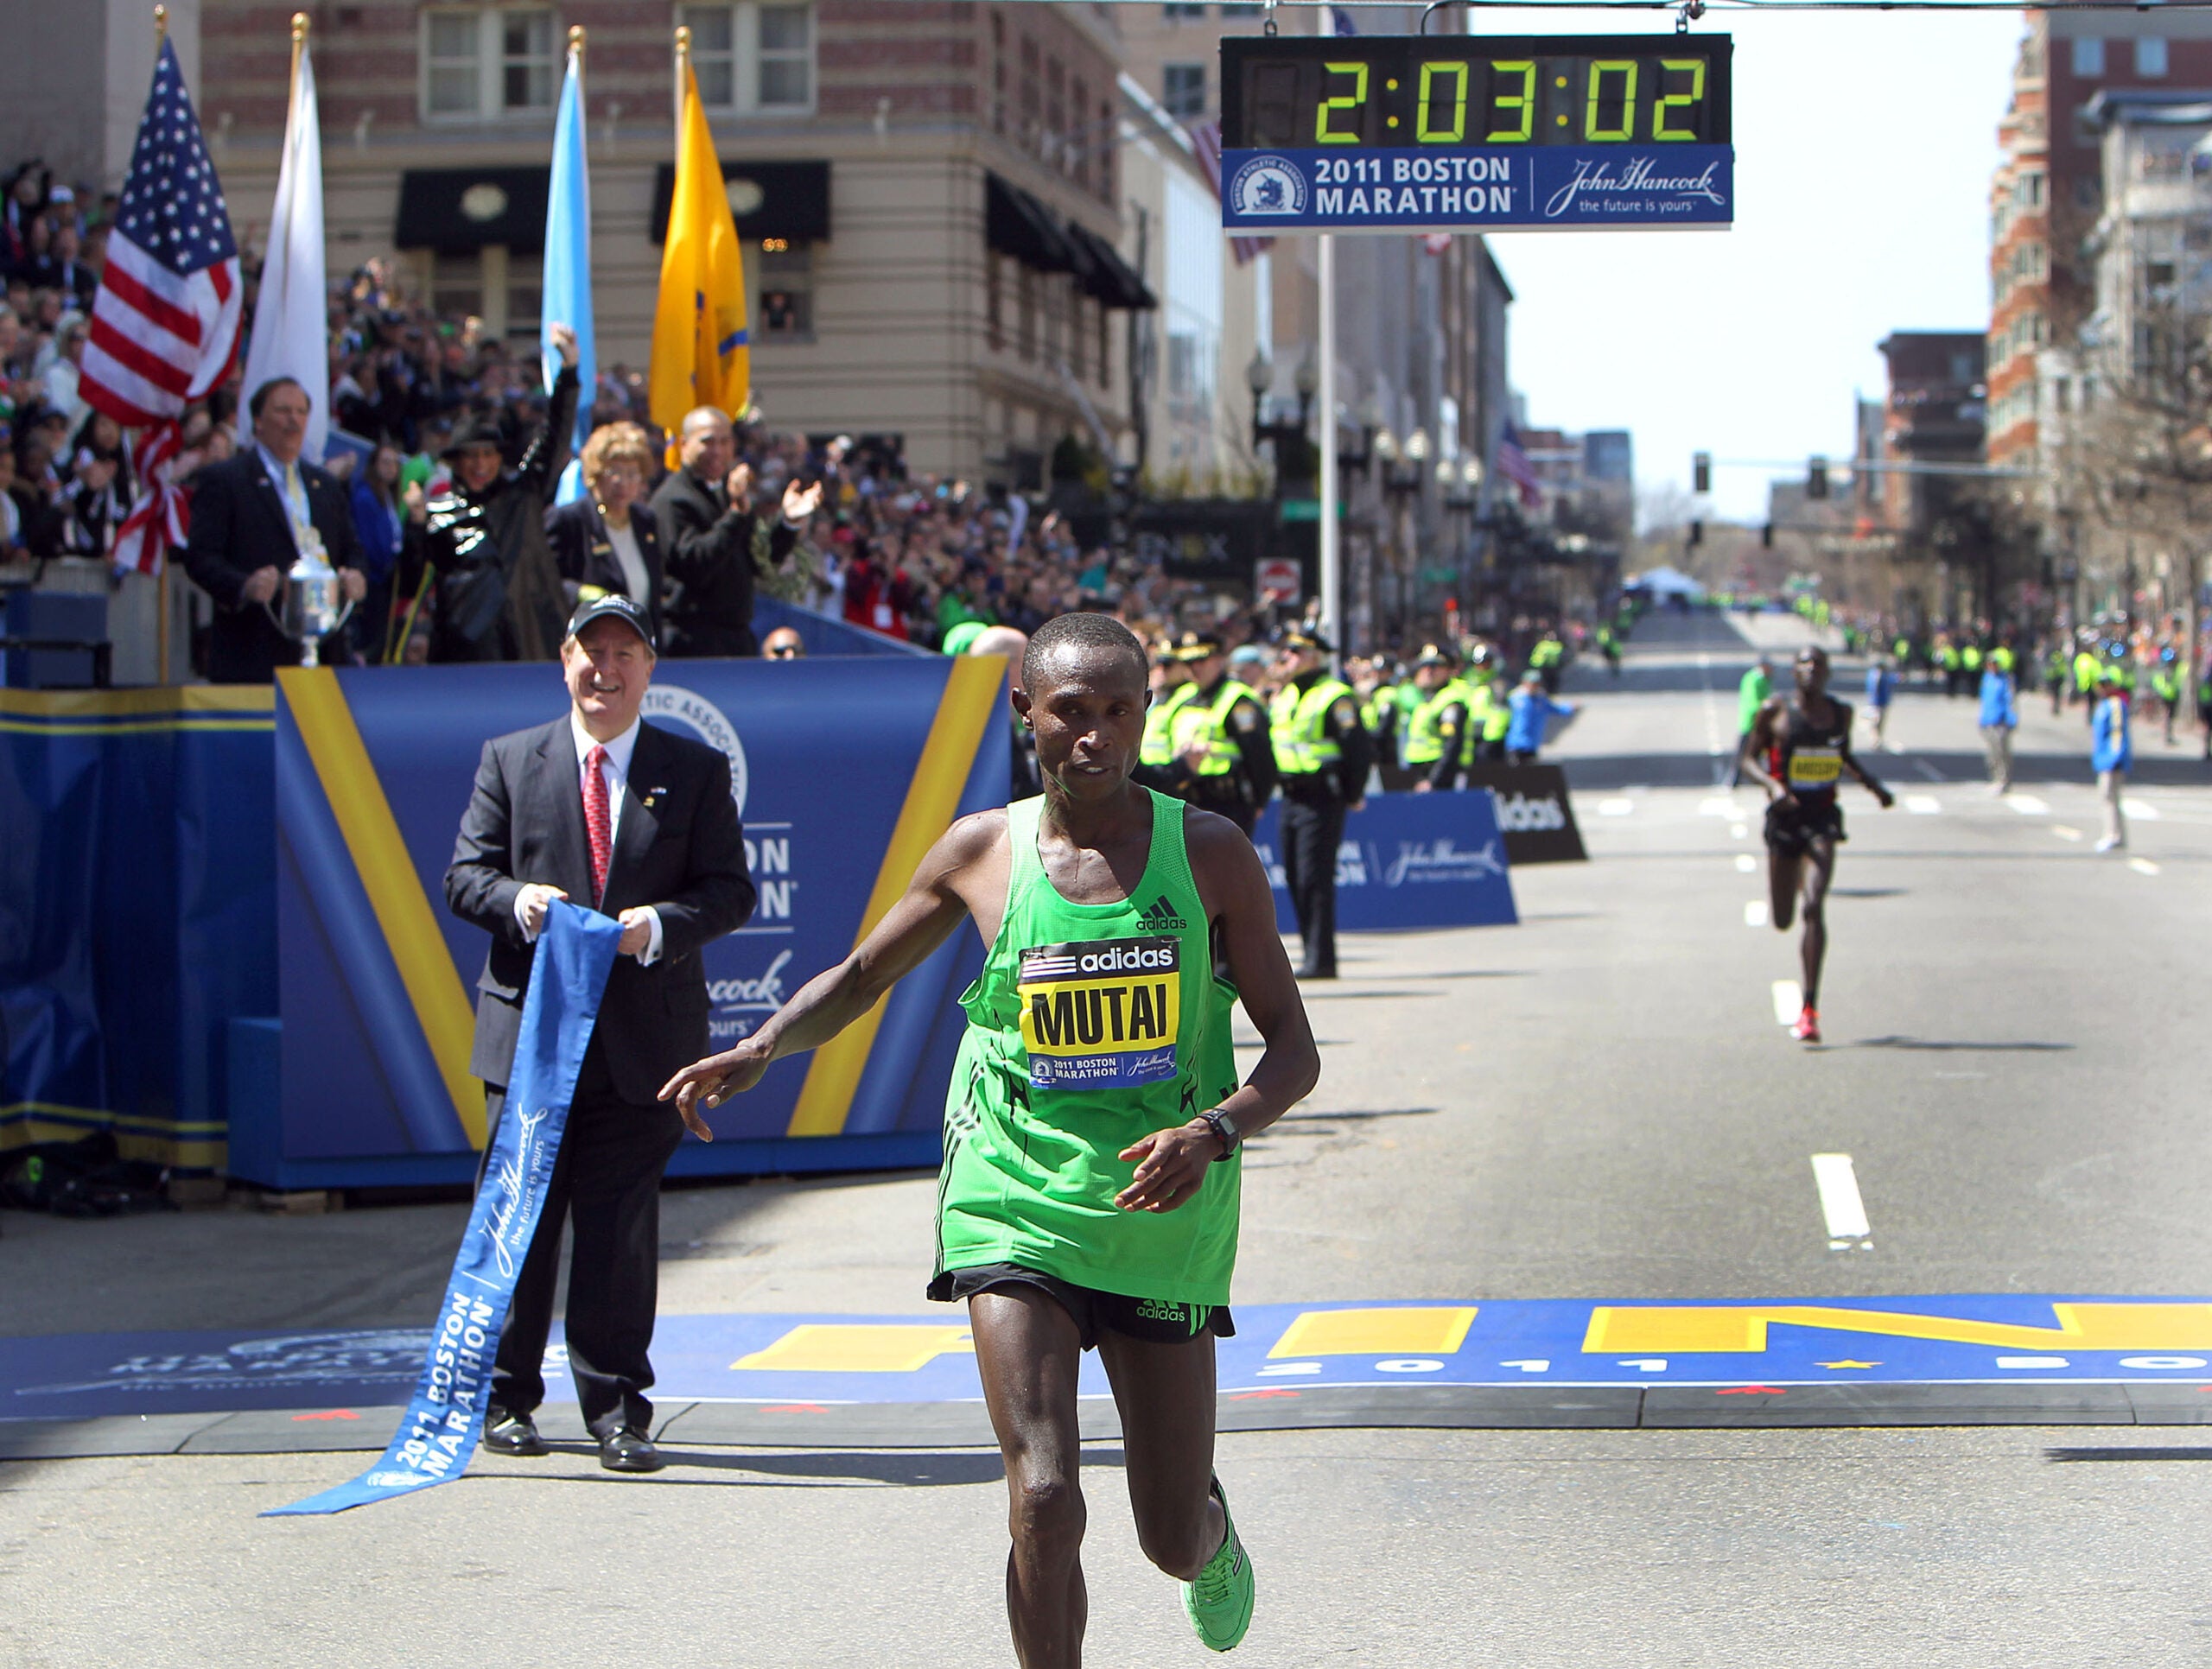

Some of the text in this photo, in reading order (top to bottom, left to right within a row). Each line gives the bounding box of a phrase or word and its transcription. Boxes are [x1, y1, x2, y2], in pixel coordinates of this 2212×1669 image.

[1315, 60, 1706, 143] 2:03:02
[1315, 157, 1510, 183] 2011 BOSTON
[1545, 156, 1726, 217] John Hancock
[1316, 187, 1511, 214] MARATHON
[1580, 199, 1693, 214] the future is yours
[1136, 917, 1187, 931] adidas
[1080, 946, 1173, 973] adidas
[1031, 983, 1166, 1047] MUTAI
[1053, 1057, 1116, 1069] 2011 BOSTON
[1054, 1067, 1117, 1079] MARATHON
[478, 1102, 548, 1279] John Hancock
[510, 1139, 545, 1246] the future is yours
[1136, 1305, 1185, 1322] adidas
[396, 1411, 442, 1468] 2011
[427, 1291, 472, 1406] BOSTON
[421, 1298, 494, 1478] MARATHON
